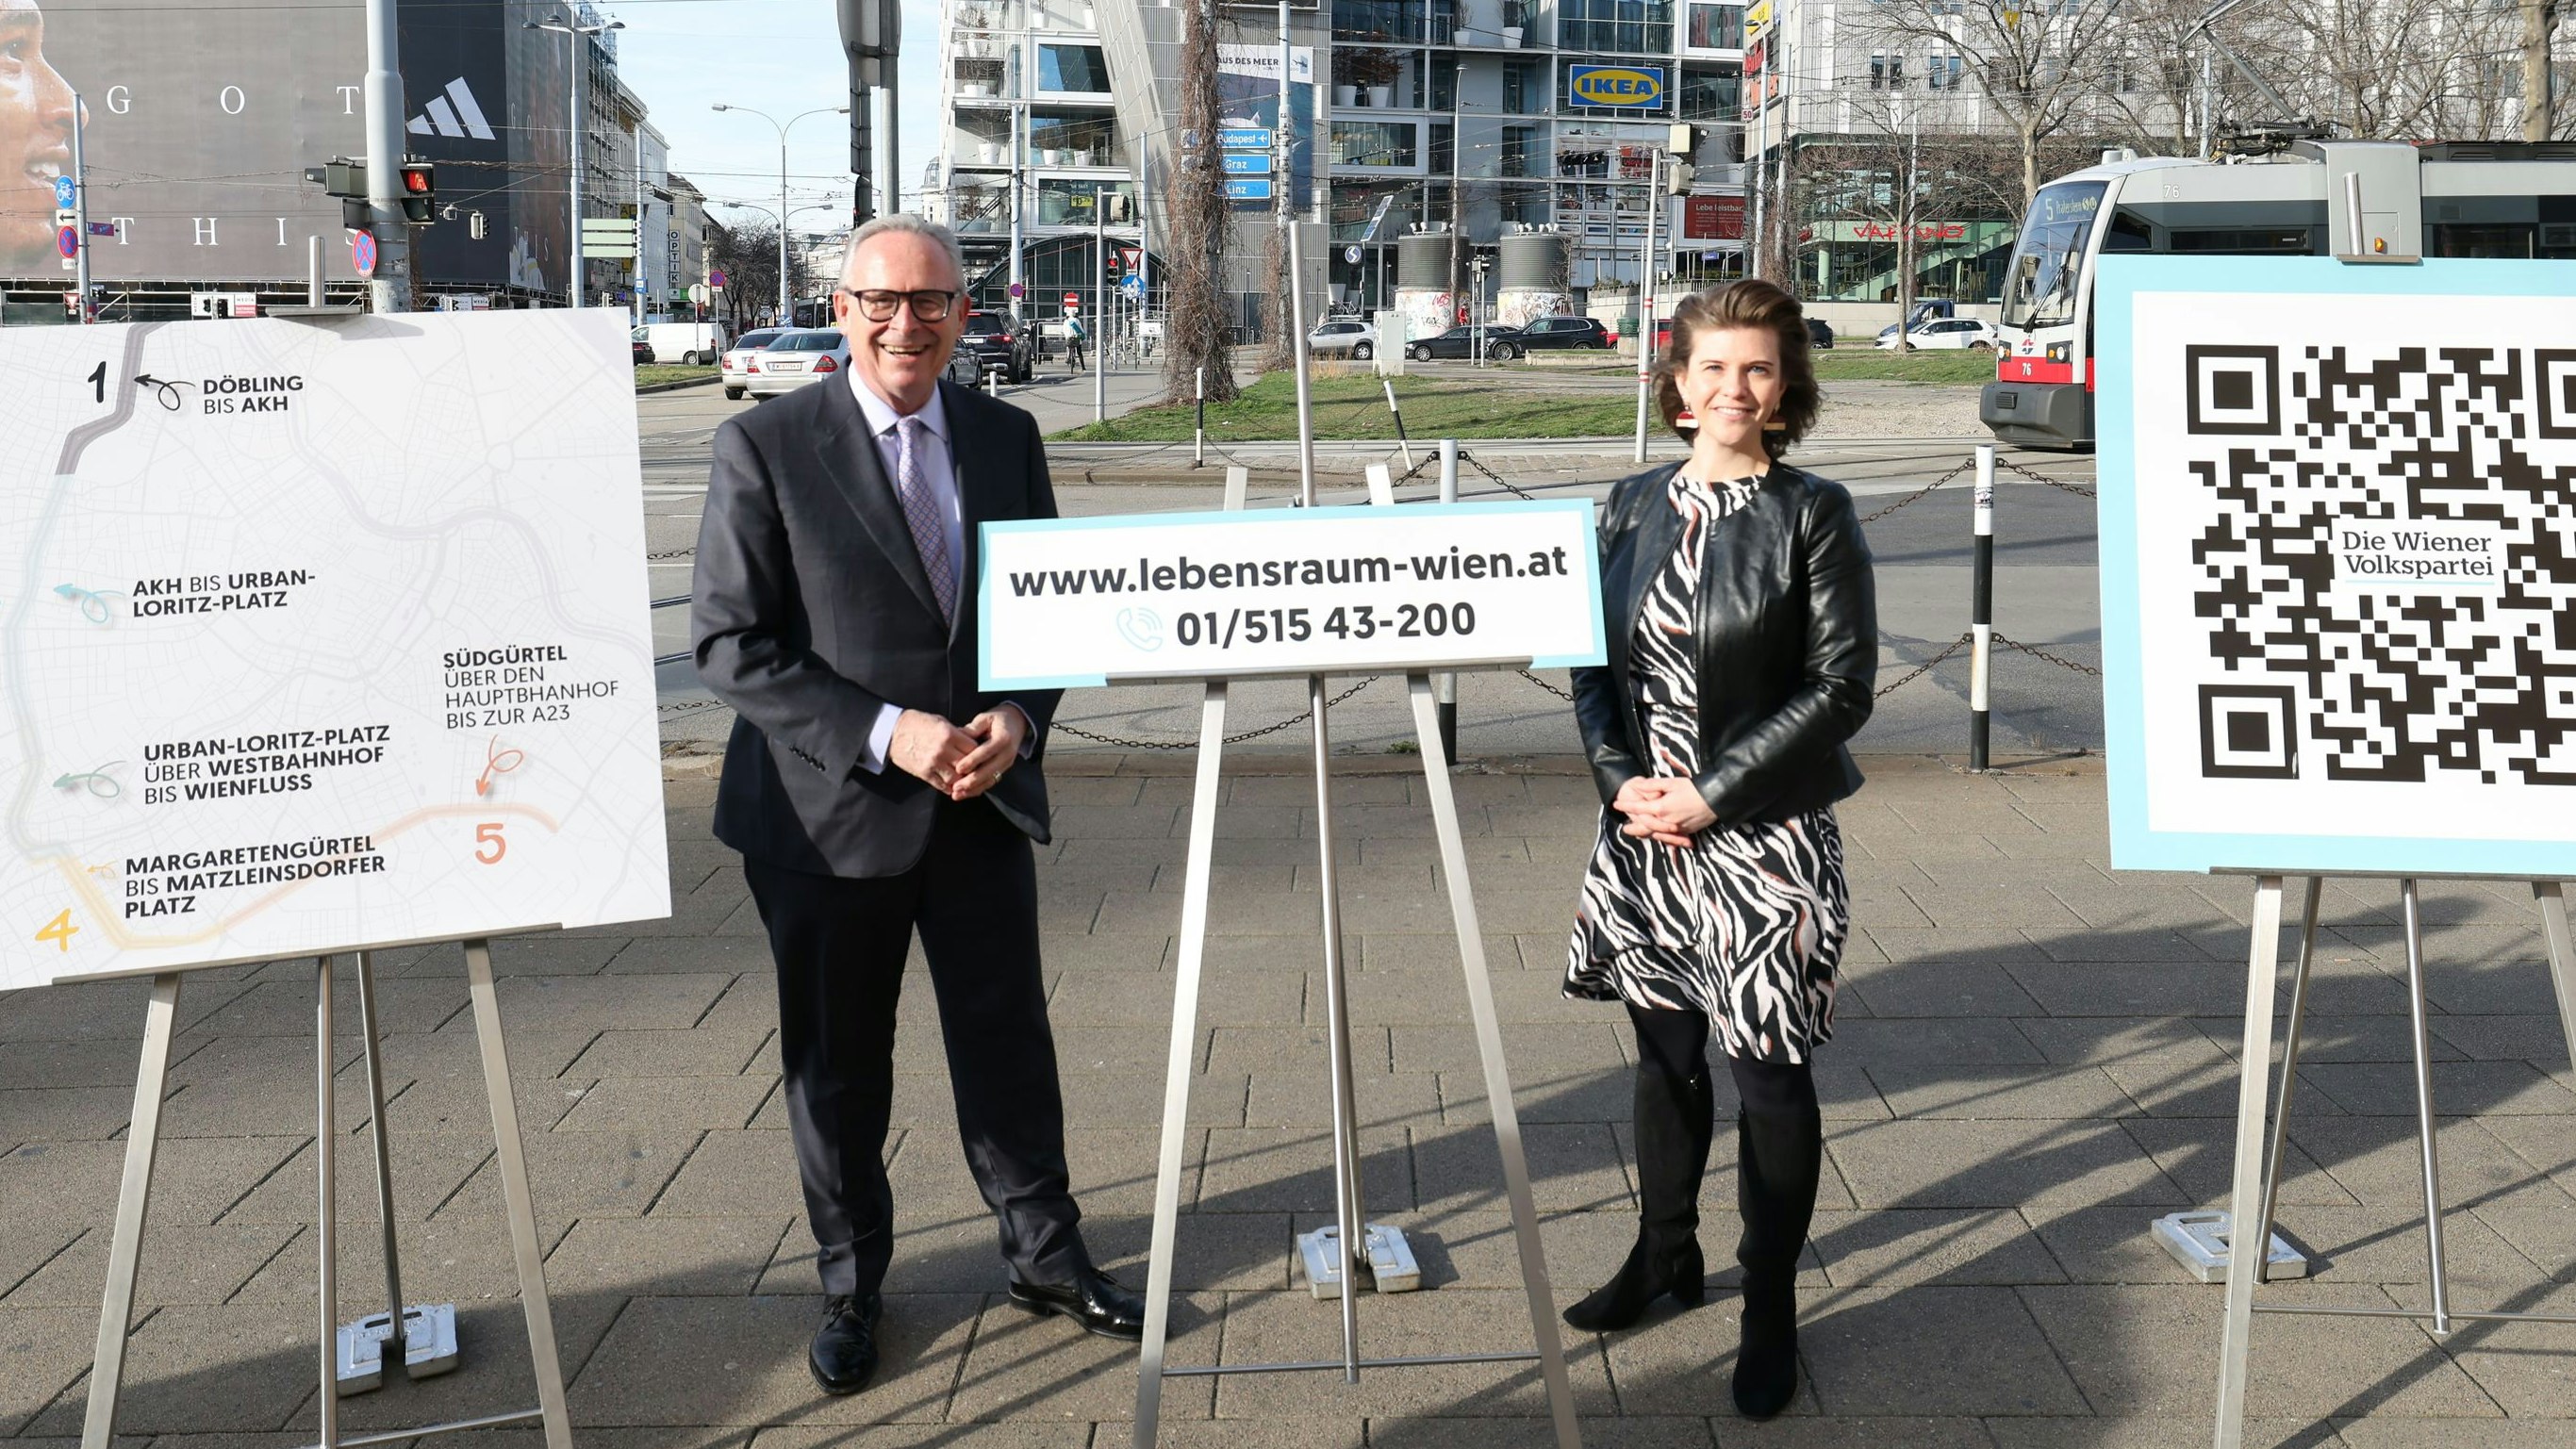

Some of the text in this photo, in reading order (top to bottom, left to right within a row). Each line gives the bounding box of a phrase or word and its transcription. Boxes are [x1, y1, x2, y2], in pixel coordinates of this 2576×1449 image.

[1581, 78, 1654, 95] IKEA
[107, 85, 360, 115] GOT
[1742, 110, 1752, 119] 50
[1217, 134, 1256, 145] Budapest
[1226, 159, 1247, 169] Graz
[1227, 184, 1247, 194] Linz
[2164, 185, 2180, 198] 76
[2045, 198, 2054, 221] 5
[670, 231, 679, 281] OPTIK
[88, 361, 107, 403] 1
[2022, 362, 2032, 376] 76
[204, 374, 304, 395] DÖBLING
[204, 396, 289, 415] BIS AKH
[2342, 531, 2492, 552] Die Wiener
[1009, 545, 1568, 598] www.lebensraum-wien.at
[2343, 554, 2495, 580] Volkspartei
[132, 568, 316, 597] AKH BIS URBAN-
[133, 590, 289, 617] LORITZ-PLATZ
[1176, 601, 1477, 649] 01/515 43-200
[443, 645, 568, 668] SÜDGÜRTEL
[445, 666, 544, 688] ÜBER DEN
[446, 681, 619, 708] HAUPTBHANHOF
[447, 704, 570, 729] BIS ZUR A23
[144, 725, 390, 761] URBAN-LORITZ-PLATZ
[144, 746, 385, 783] ÜBER WESTBAHNHOF
[144, 773, 313, 805] BIS WIENFLUSS
[125, 835, 376, 875] MARGARETENGÜRTEL
[474, 822, 506, 864] 5
[125, 855, 386, 897] BIS MATZLEINSDORFER
[124, 896, 196, 919] PLATZ
[35, 908, 80, 952] 4
